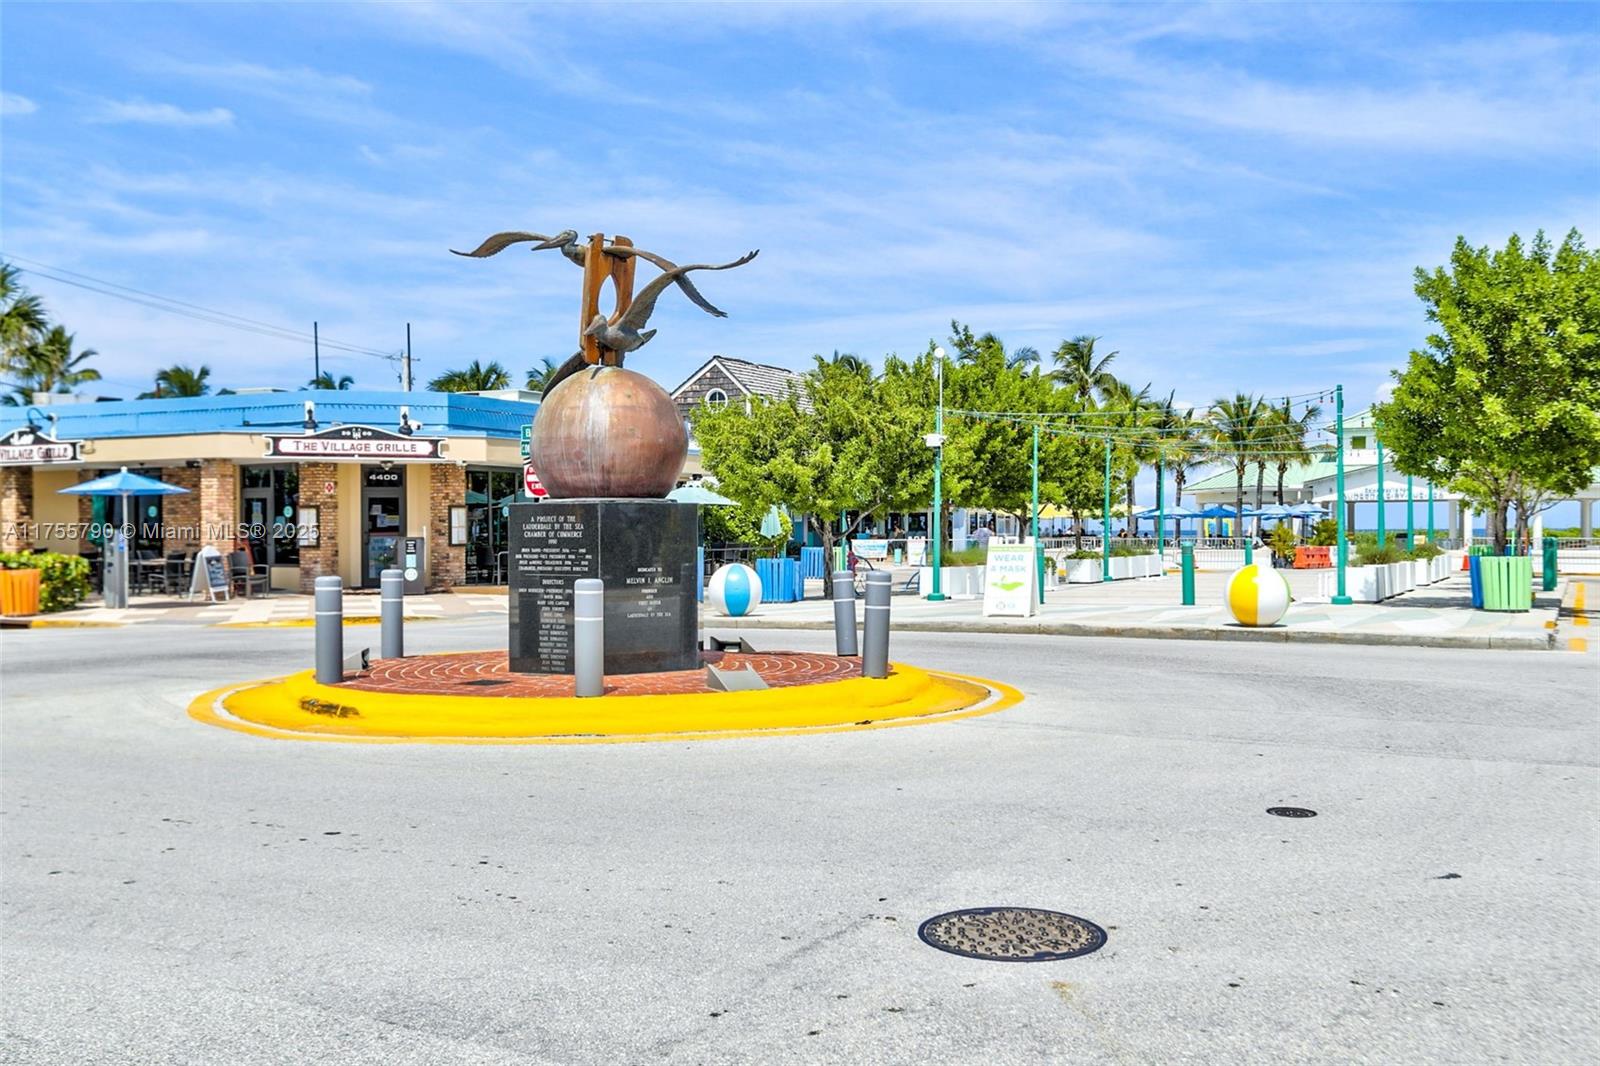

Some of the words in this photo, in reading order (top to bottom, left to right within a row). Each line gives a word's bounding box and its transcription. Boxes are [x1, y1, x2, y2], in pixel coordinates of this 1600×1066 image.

[293, 440, 318, 452] THE
[322, 441, 372, 452] VILLAGE
[376, 442, 418, 454] GRILLE
